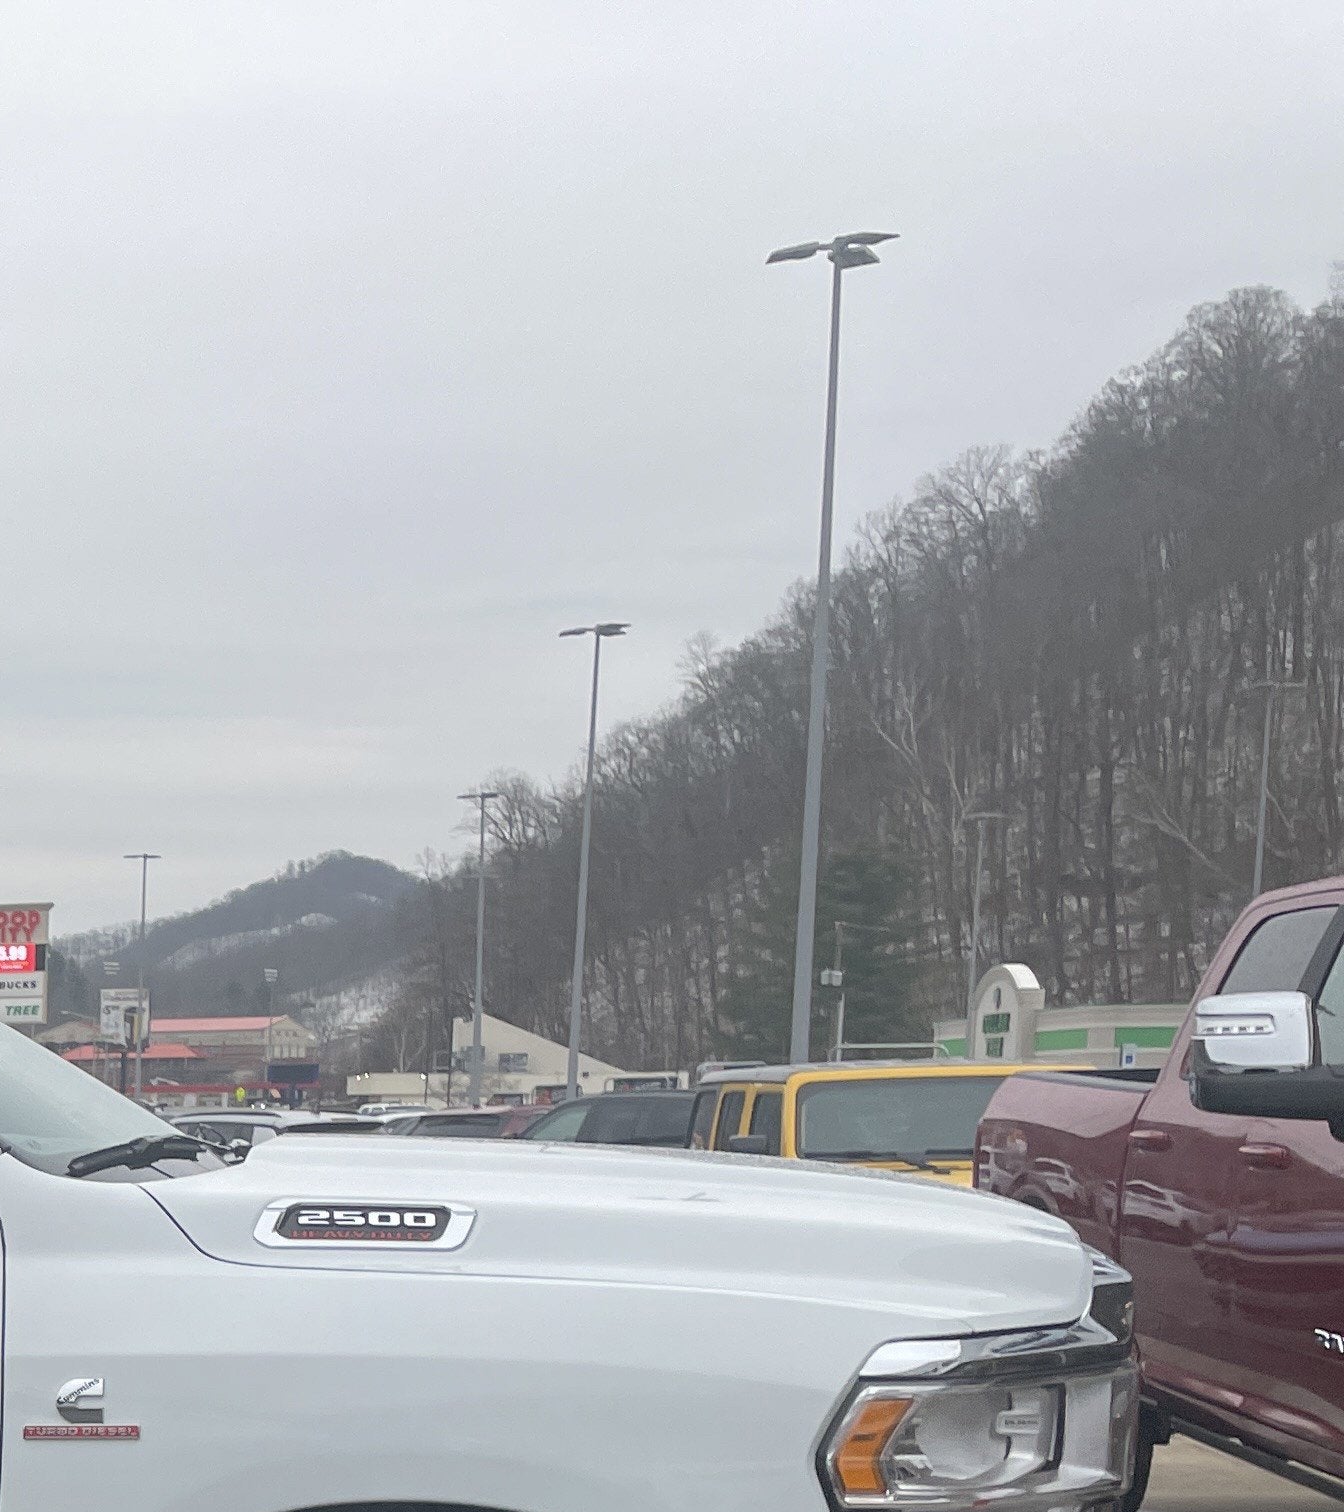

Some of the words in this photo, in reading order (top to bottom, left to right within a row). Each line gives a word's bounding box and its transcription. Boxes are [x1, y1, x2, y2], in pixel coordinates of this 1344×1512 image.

[5, 1005, 40, 1016] TREE
[297, 1209, 437, 1228] 2500
[289, 1229, 364, 1240] HEAVY
[56, 1377, 100, 1405] Cummins
[25, 1427, 79, 1437] TURBO
[81, 1427, 138, 1437] DIESEL
